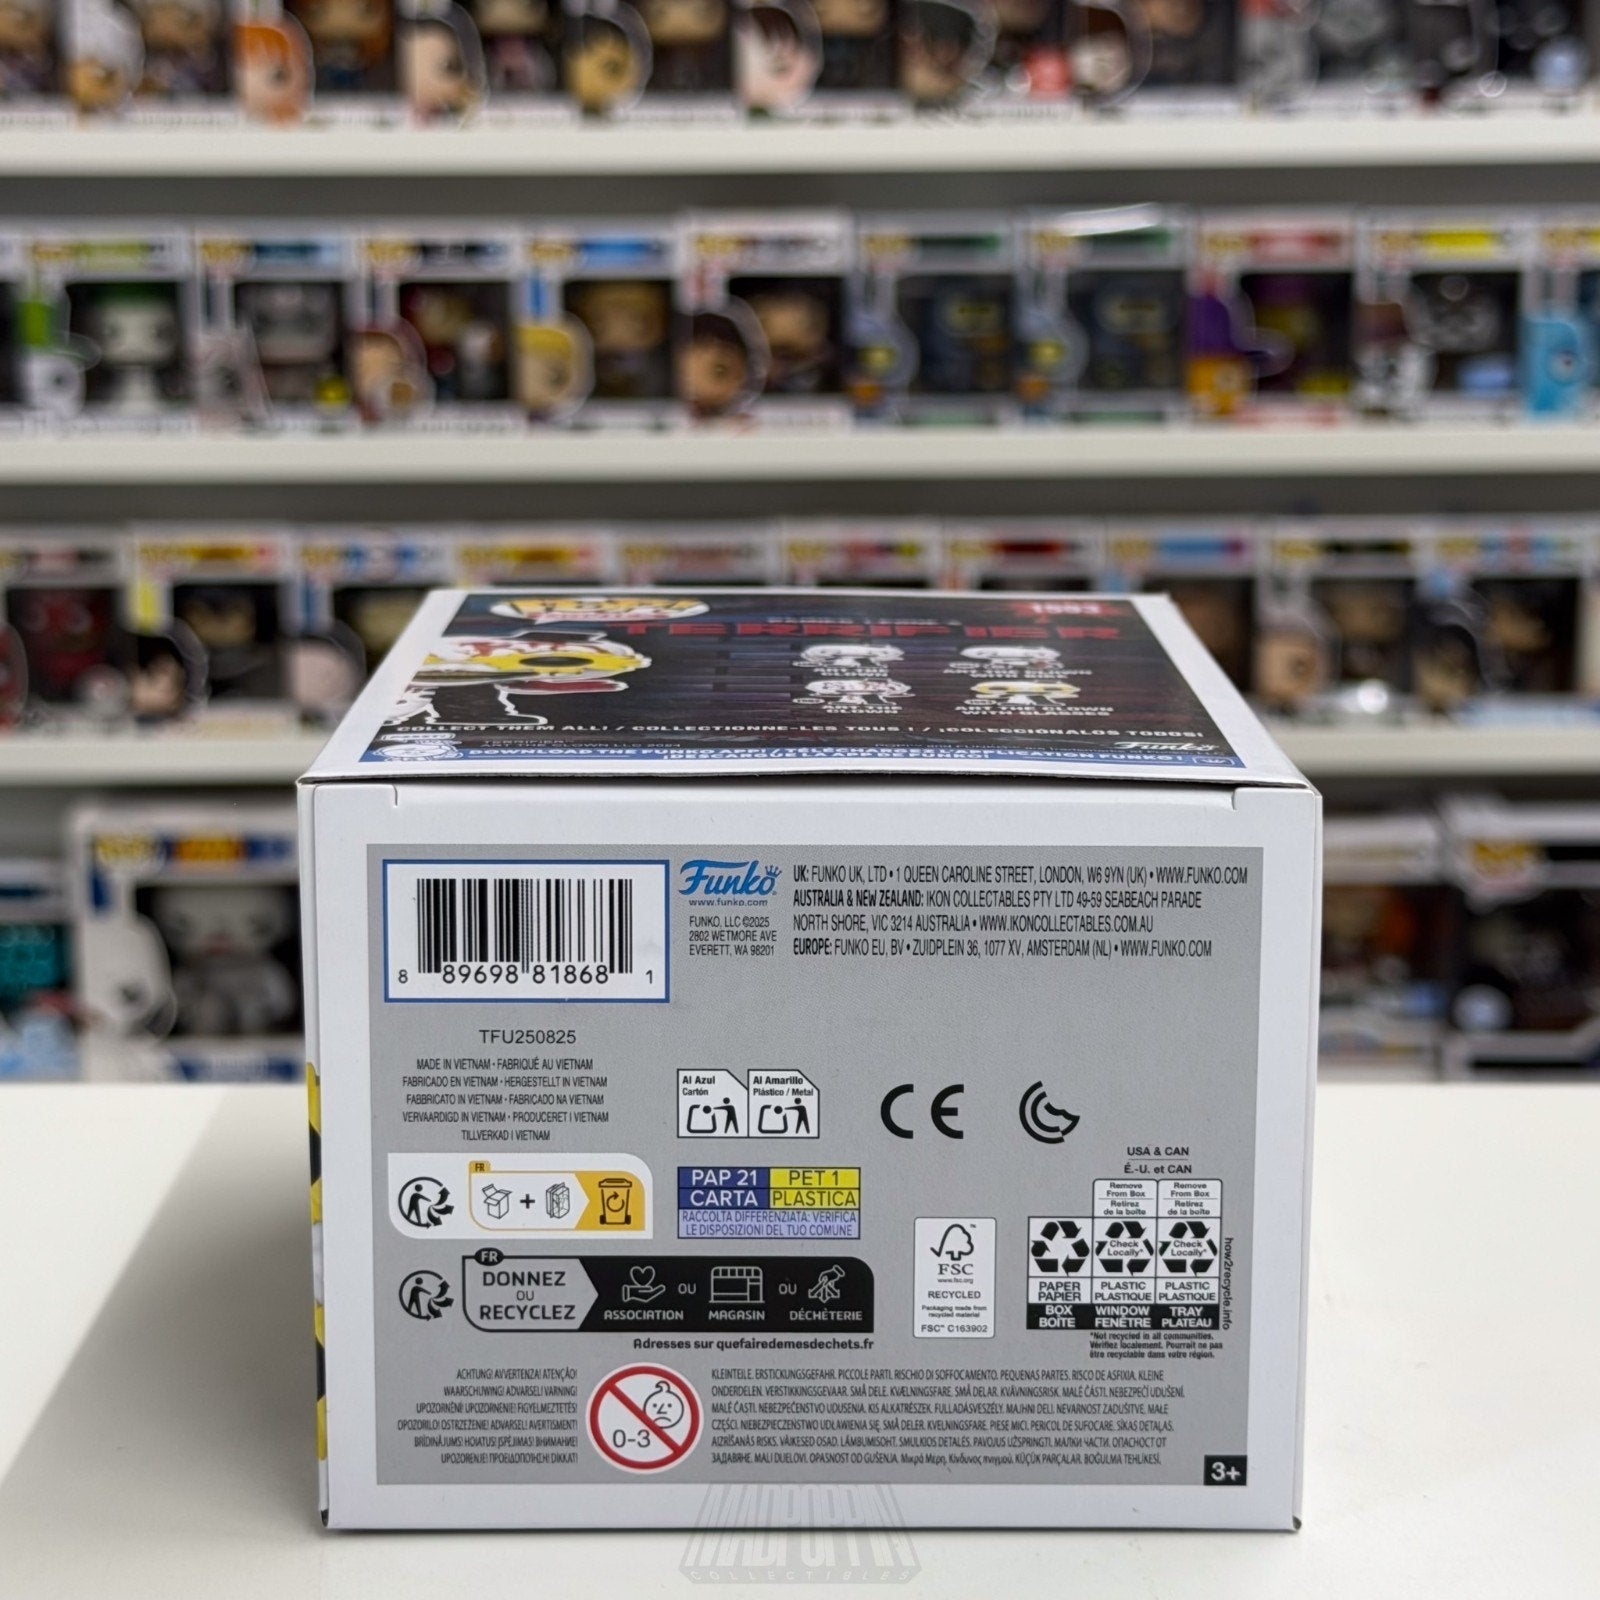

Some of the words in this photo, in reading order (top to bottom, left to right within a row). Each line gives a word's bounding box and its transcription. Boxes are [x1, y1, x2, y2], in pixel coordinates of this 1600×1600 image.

[1125, 730, 1204, 738] TODOS!
[1112, 741, 1217, 751] Funko
[678, 859, 781, 896] Funko
[793, 865, 809, 882] UK:
[812, 865, 846, 883] FUNKO
[849, 865, 865, 885] UK,
[868, 865, 887, 882] LTD
[896, 867, 900, 882] 1
[904, 865, 939, 883] QUEEN
[942, 865, 992, 883] CAROLINE
[995, 866, 1036, 885] STREET,
[1039, 865, 1084, 885] LONDON,
[1087, 866, 1102, 883] W6
[1104, 866, 1124, 884] 9YN
[1127, 866, 1147, 885] (UK)
[1156, 866, 1248, 884] WWW.FUNKO.COM
[793, 889, 844, 907] AUSTRALIA
[847, 889, 853, 907] &
[856, 889, 877, 907] NEW
[879, 889, 924, 907] ZEALAND:
[927, 890, 950, 907] IKON
[953, 890, 1030, 908] COLLECTABLES
[1033, 890, 1052, 907] PTY
[1055, 890, 1074, 907] LTD
[1076, 891, 1102, 908] 49-59
[1105, 890, 1158, 908] SEABEACH
[1161, 891, 1202, 908] PARADE
[689, 915, 722, 929] FUNKO,
[724, 916, 741, 928] LLC
[793, 914, 828, 931] NORTH
[831, 914, 869, 934] SHORE,
[871, 914, 888, 931] VIC
[890, 915, 913, 931] 3214
[915, 914, 970, 932] AUSTRALIA
[979, 915, 1153, 933] WWW.IKONCOLLECTABLES.COM.AU
[689, 930, 709, 942] 2802
[711, 930, 757, 942] WETMORE
[759, 930, 777, 942] AVE
[689, 944, 732, 956] EVERETT,
[734, 944, 748, 956] WA
[750, 944, 774, 956] 98201
[793, 938, 832, 956] EUROPE:
[835, 938, 869, 956] FUNKO
[872, 939, 888, 956] EU,
[891, 939, 904, 956] BV
[912, 938, 964, 956] ZUIDPLEIN
[967, 939, 980, 958] 36,
[984, 940, 1006, 956] 1077
[1008, 939, 1024, 958] XV,
[1026, 939, 1090, 956] AMSTERDAM
[1092, 939, 1112, 958] (NL)
[1120, 940, 1212, 957] WWW.FUNKO.COM
[398, 969, 408, 984] 8
[440, 965, 522, 984] 89698
[532, 965, 611, 984] 81868
[646, 970, 653, 984] 1
[478, 1030, 576, 1044] TFU250825
[417, 1058, 441, 1070] MADE
[443, 1059, 452, 1070] IN
[453, 1058, 491, 1070] VIETNAM
[497, 1057, 539, 1070] FABRIQUÉ
[542, 1059, 553, 1070] AU
[555, 1058, 593, 1070] VIETNAM
[682, 1075, 692, 1084] Al
[695, 1076, 715, 1084] Azul
[753, 1076, 762, 1084] Al
[765, 1075, 804, 1085] Amarillo
[682, 1087, 709, 1096] Cartón
[753, 1088, 784, 1096] Plástico
[791, 1087, 814, 1096] Metal
[1127, 1146, 1151, 1156] USA
[1153, 1147, 1161, 1156] &
[1164, 1147, 1189, 1156] CAN
[1154, 1165, 1165, 1174] et
[1167, 1164, 1192, 1174] CAN
[692, 1169, 731, 1186] PAP
[737, 1169, 756, 1186] 21
[789, 1169, 829, 1186] PET
[832, 1169, 839, 1186] 1
[690, 1190, 758, 1206] CARTA
[772, 1190, 856, 1207] PLASTICA
[683, 1210, 733, 1222] RACCOLTA
[735, 1210, 810, 1222] DIFFERENZIATA:
[812, 1210, 857, 1222] VERIFICA
[938, 1263, 973, 1275] FSC
[483, 1271, 566, 1286] DONNEZ
[1222, 1237, 1234, 1331] how2recycle.info
[678, 1283, 696, 1295] OU
[1039, 1281, 1081, 1291] PAPER
[1101, 1281, 1146, 1290] PLASTIC
[516, 1290, 534, 1301] OU
[928, 1291, 981, 1299] RECYCLED
[1038, 1291, 1081, 1302] PAPIER
[1095, 1292, 1152, 1301] PLASTIQUE
[480, 1305, 576, 1320] RECYCLEZ
[604, 1310, 684, 1320] ASSOCIATION
[708, 1310, 765, 1320] MAGASIN
[789, 1308, 862, 1321] DÉCHÈTERIE
[1045, 1305, 1072, 1315] BOX
[1095, 1305, 1150, 1315] WINDOW
[1169, 1306, 1203, 1316] TRAY
[1039, 1315, 1075, 1328] BOÎTE
[1095, 1315, 1151, 1328] FENÊTRE
[1162, 1316, 1212, 1328] PLATEAU
[947, 1324, 988, 1333] C163902
[633, 1338, 691, 1349] Adresses
[694, 1341, 714, 1349] sur
[716, 1337, 874, 1351] quefairedemesdechets.fr
[456, 1368, 493, 1380] ACHTUNG!
[1000, 1369, 1040, 1381] PEQUENAS
[1041, 1369, 1071, 1381] PARTES.
[1072, 1369, 1094, 1381] RISCO
[1095, 1370, 1105, 1381] DE
[1138, 1370, 1164, 1381] KLEINE
[612, 1429, 651, 1448] 0-3
[1211, 1462, 1241, 1481] 3+
